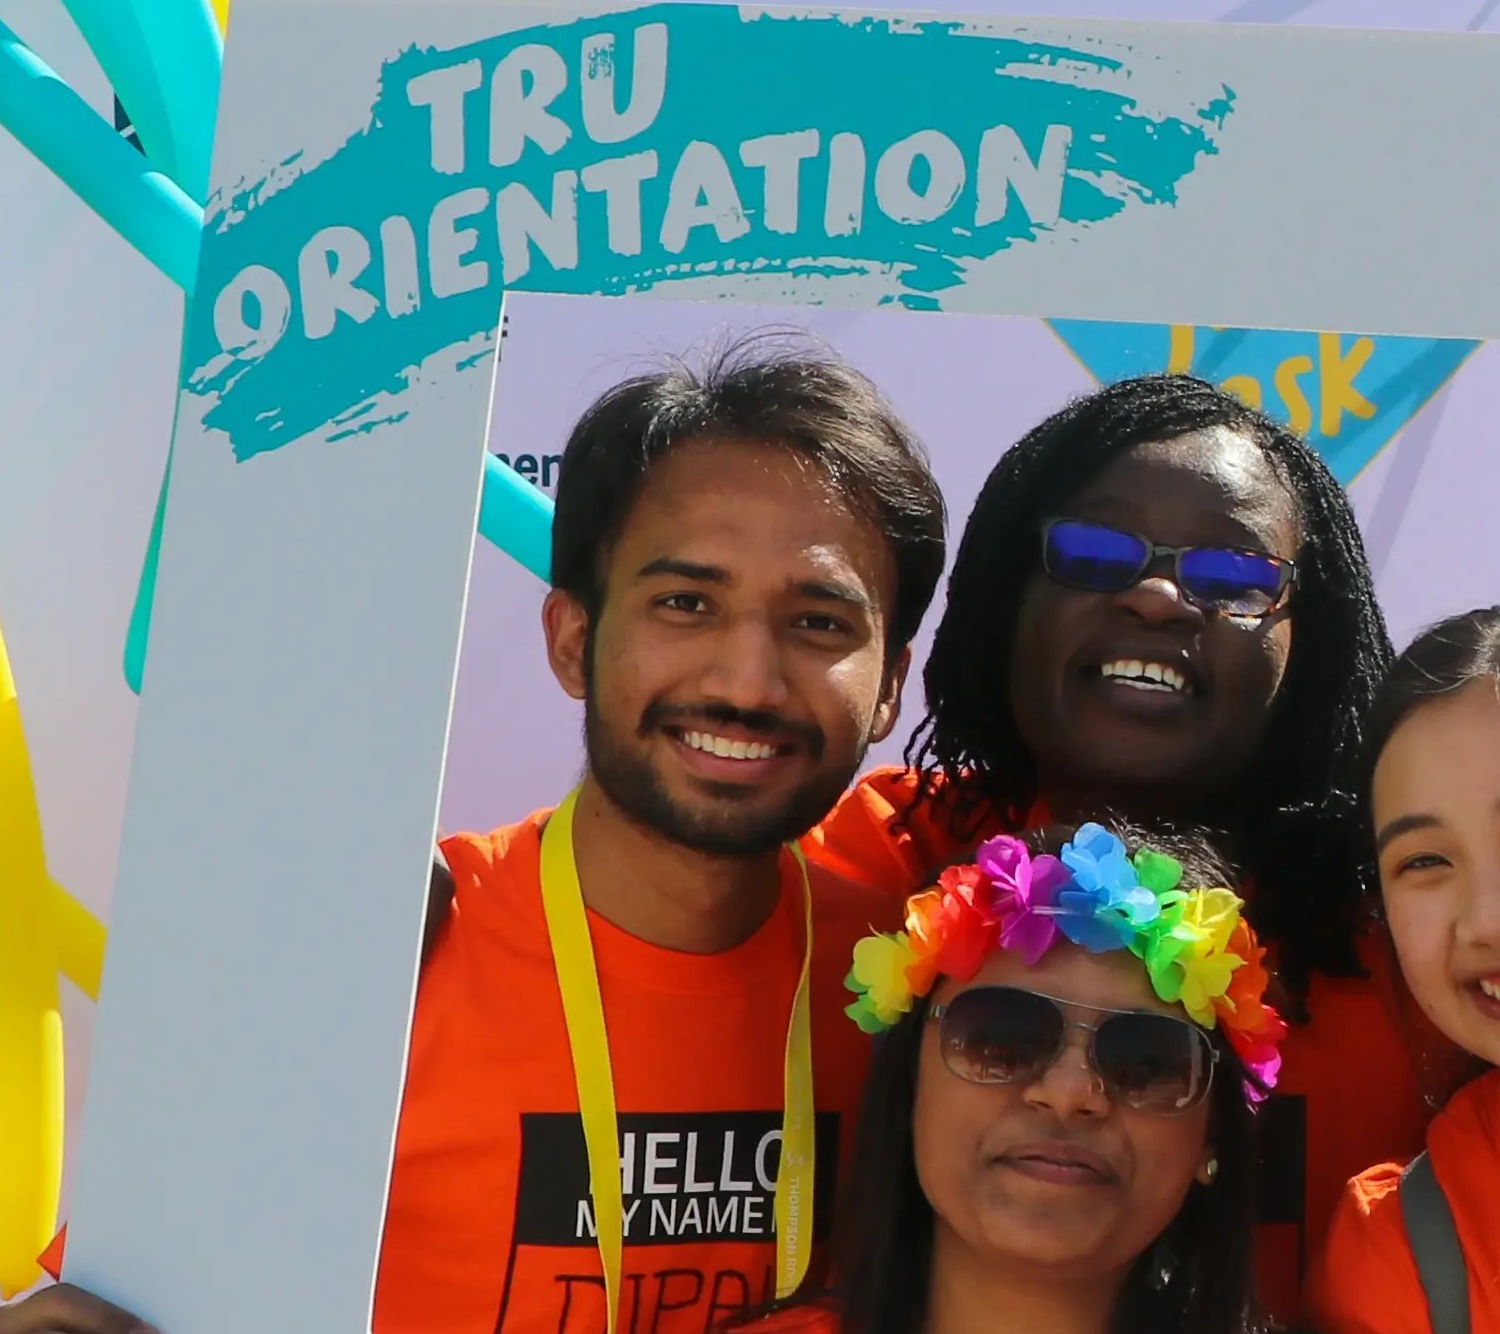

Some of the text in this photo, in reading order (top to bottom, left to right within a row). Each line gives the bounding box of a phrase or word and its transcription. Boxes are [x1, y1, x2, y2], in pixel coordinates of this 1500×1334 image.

[407, 23, 668, 175] TRU
[213, 122, 1073, 362] ORIENTATION
[649, 1196, 765, 1236] NAME
